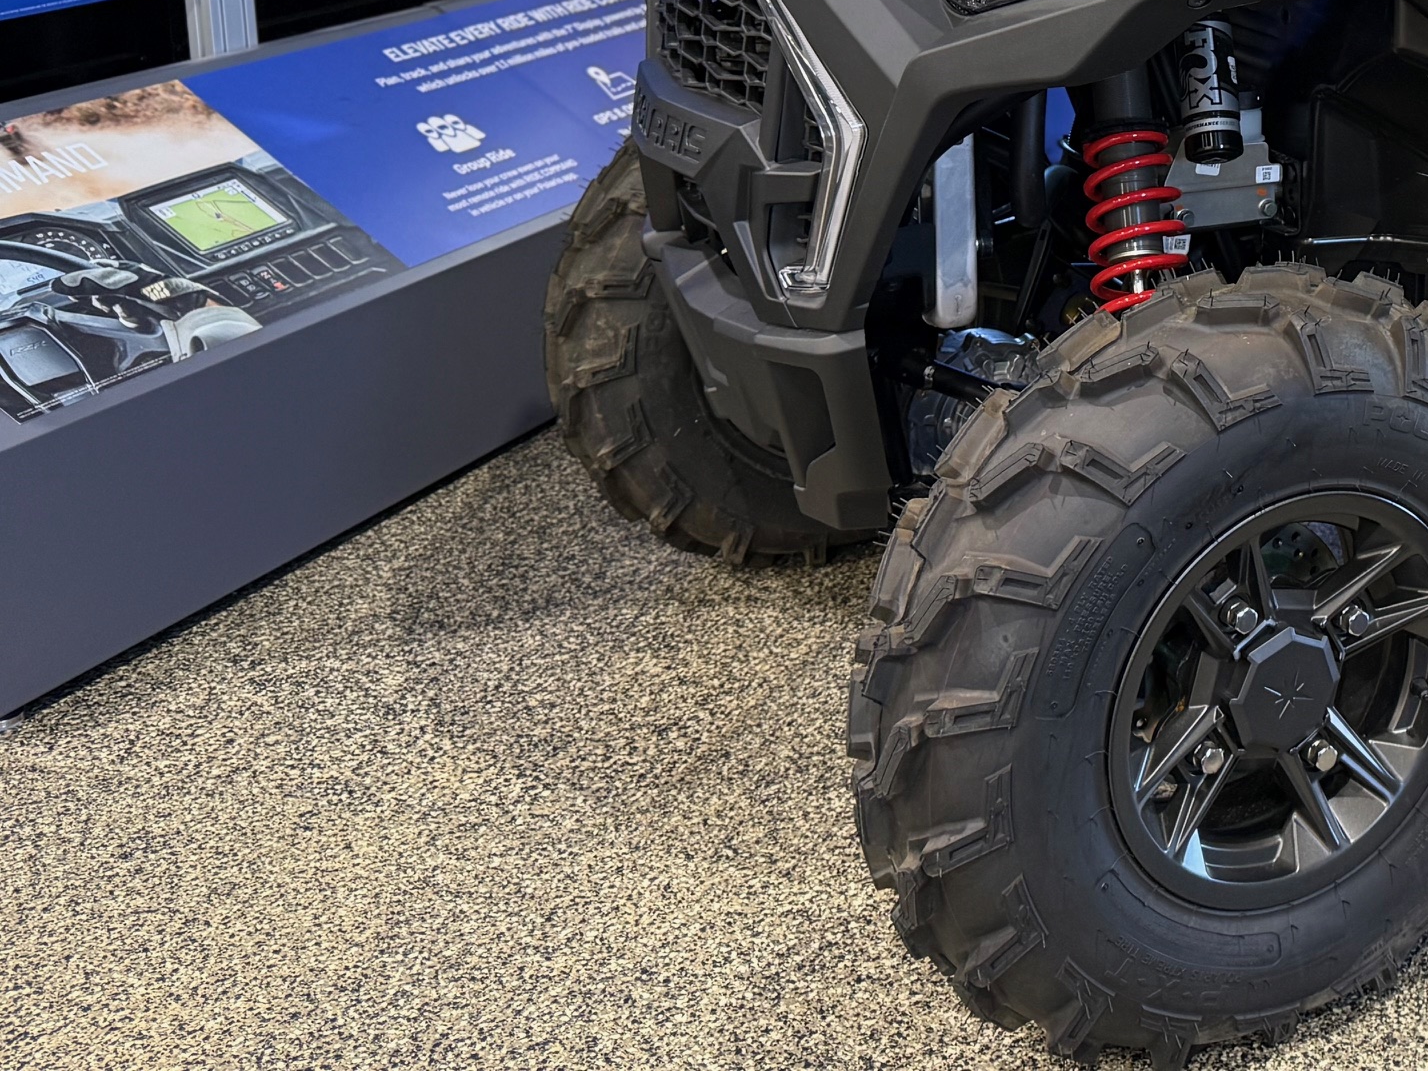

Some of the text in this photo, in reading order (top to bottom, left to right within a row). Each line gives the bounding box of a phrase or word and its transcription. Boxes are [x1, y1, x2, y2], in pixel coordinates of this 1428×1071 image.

[382, 34, 457, 62] ELEVATE
[448, 20, 501, 46] EVERY
[496, 12, 536, 31] RIDE
[527, 3, 569, 22] WITH
[375, 75, 405, 87] Plan,
[399, 67, 431, 80] track,
[428, 61, 449, 74] and
[446, 56, 473, 68] share
[1179, 27, 1223, 110] FOX
[0, 142, 109, 193] MAND
[452, 148, 516, 175] Group Ride
[1377, 456, 1409, 475] MADE
[1114, 935, 1141, 959] TIRE
